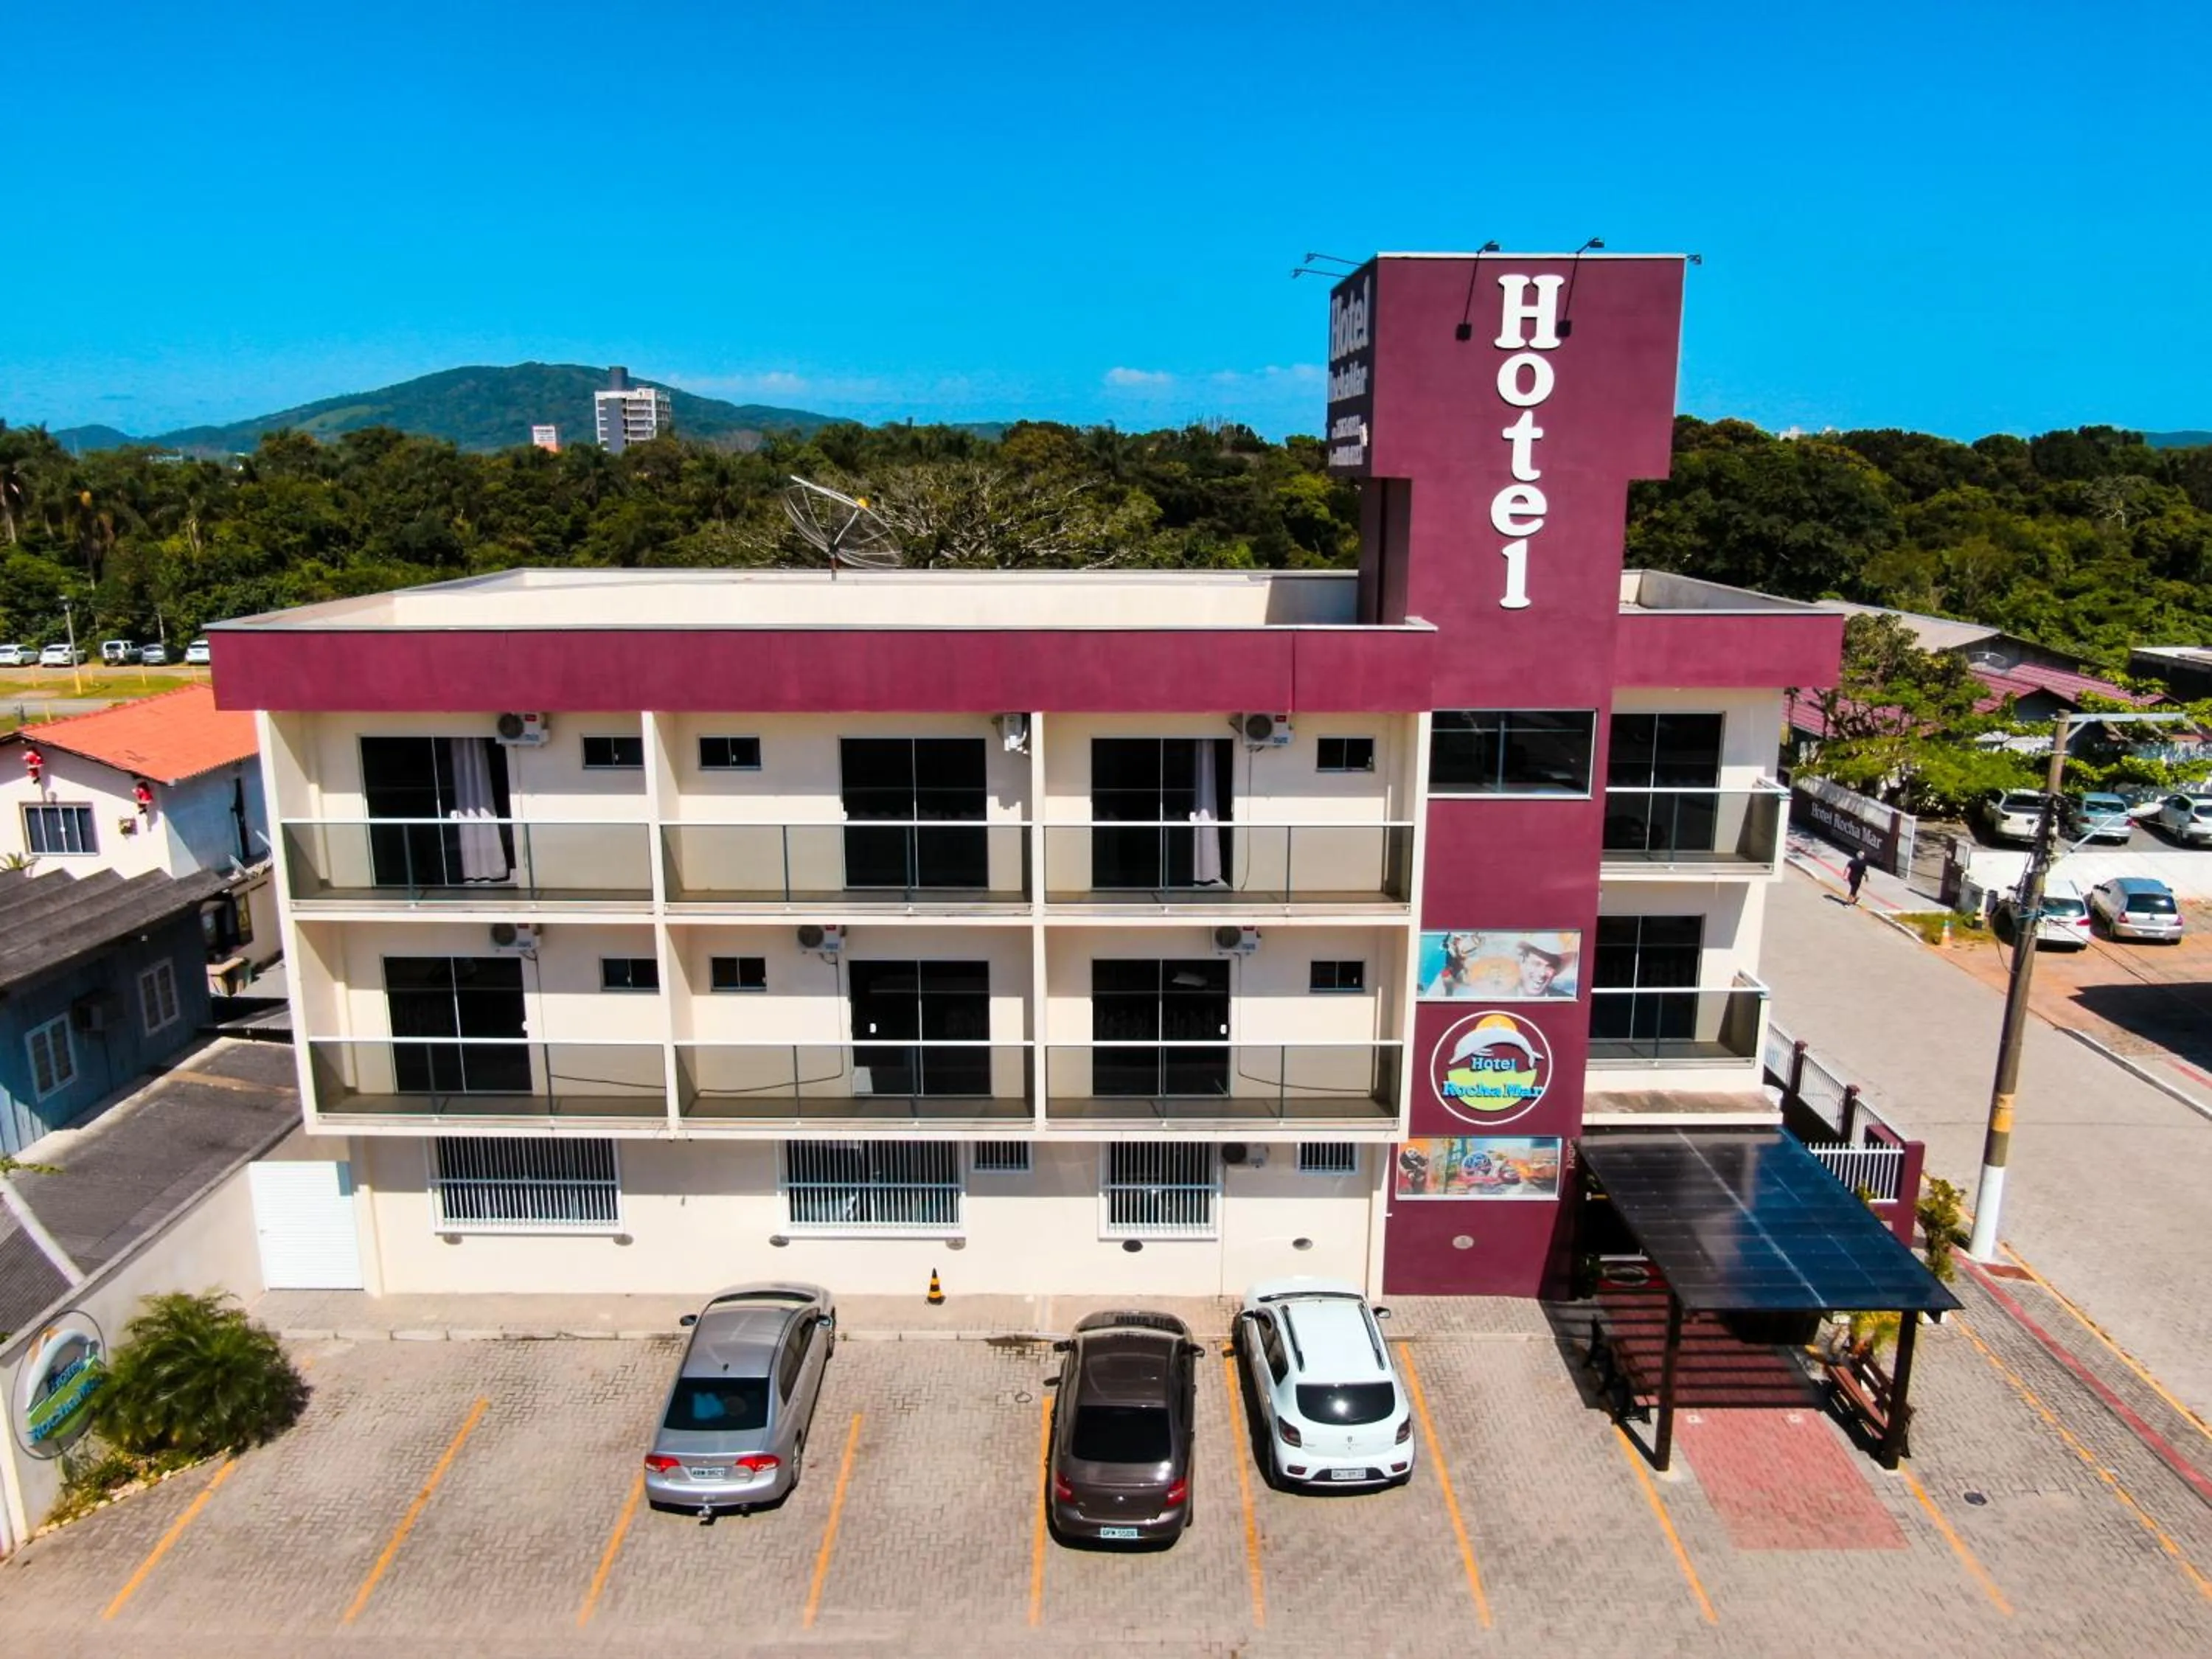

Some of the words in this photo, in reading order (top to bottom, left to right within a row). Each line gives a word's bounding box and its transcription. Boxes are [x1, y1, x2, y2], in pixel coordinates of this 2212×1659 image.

[1329, 275, 1370, 361] Hotel
[1490, 274, 1565, 609] Hotel
[1811, 802, 1832, 825] Hotel
[1834, 813, 1860, 838] Rocha
[1861, 826, 1882, 849] Mar
[1471, 1057, 1517, 1071] Hotel
[1442, 1080, 1502, 1097] Rocha
[1504, 1082, 1544, 1099] Mar
